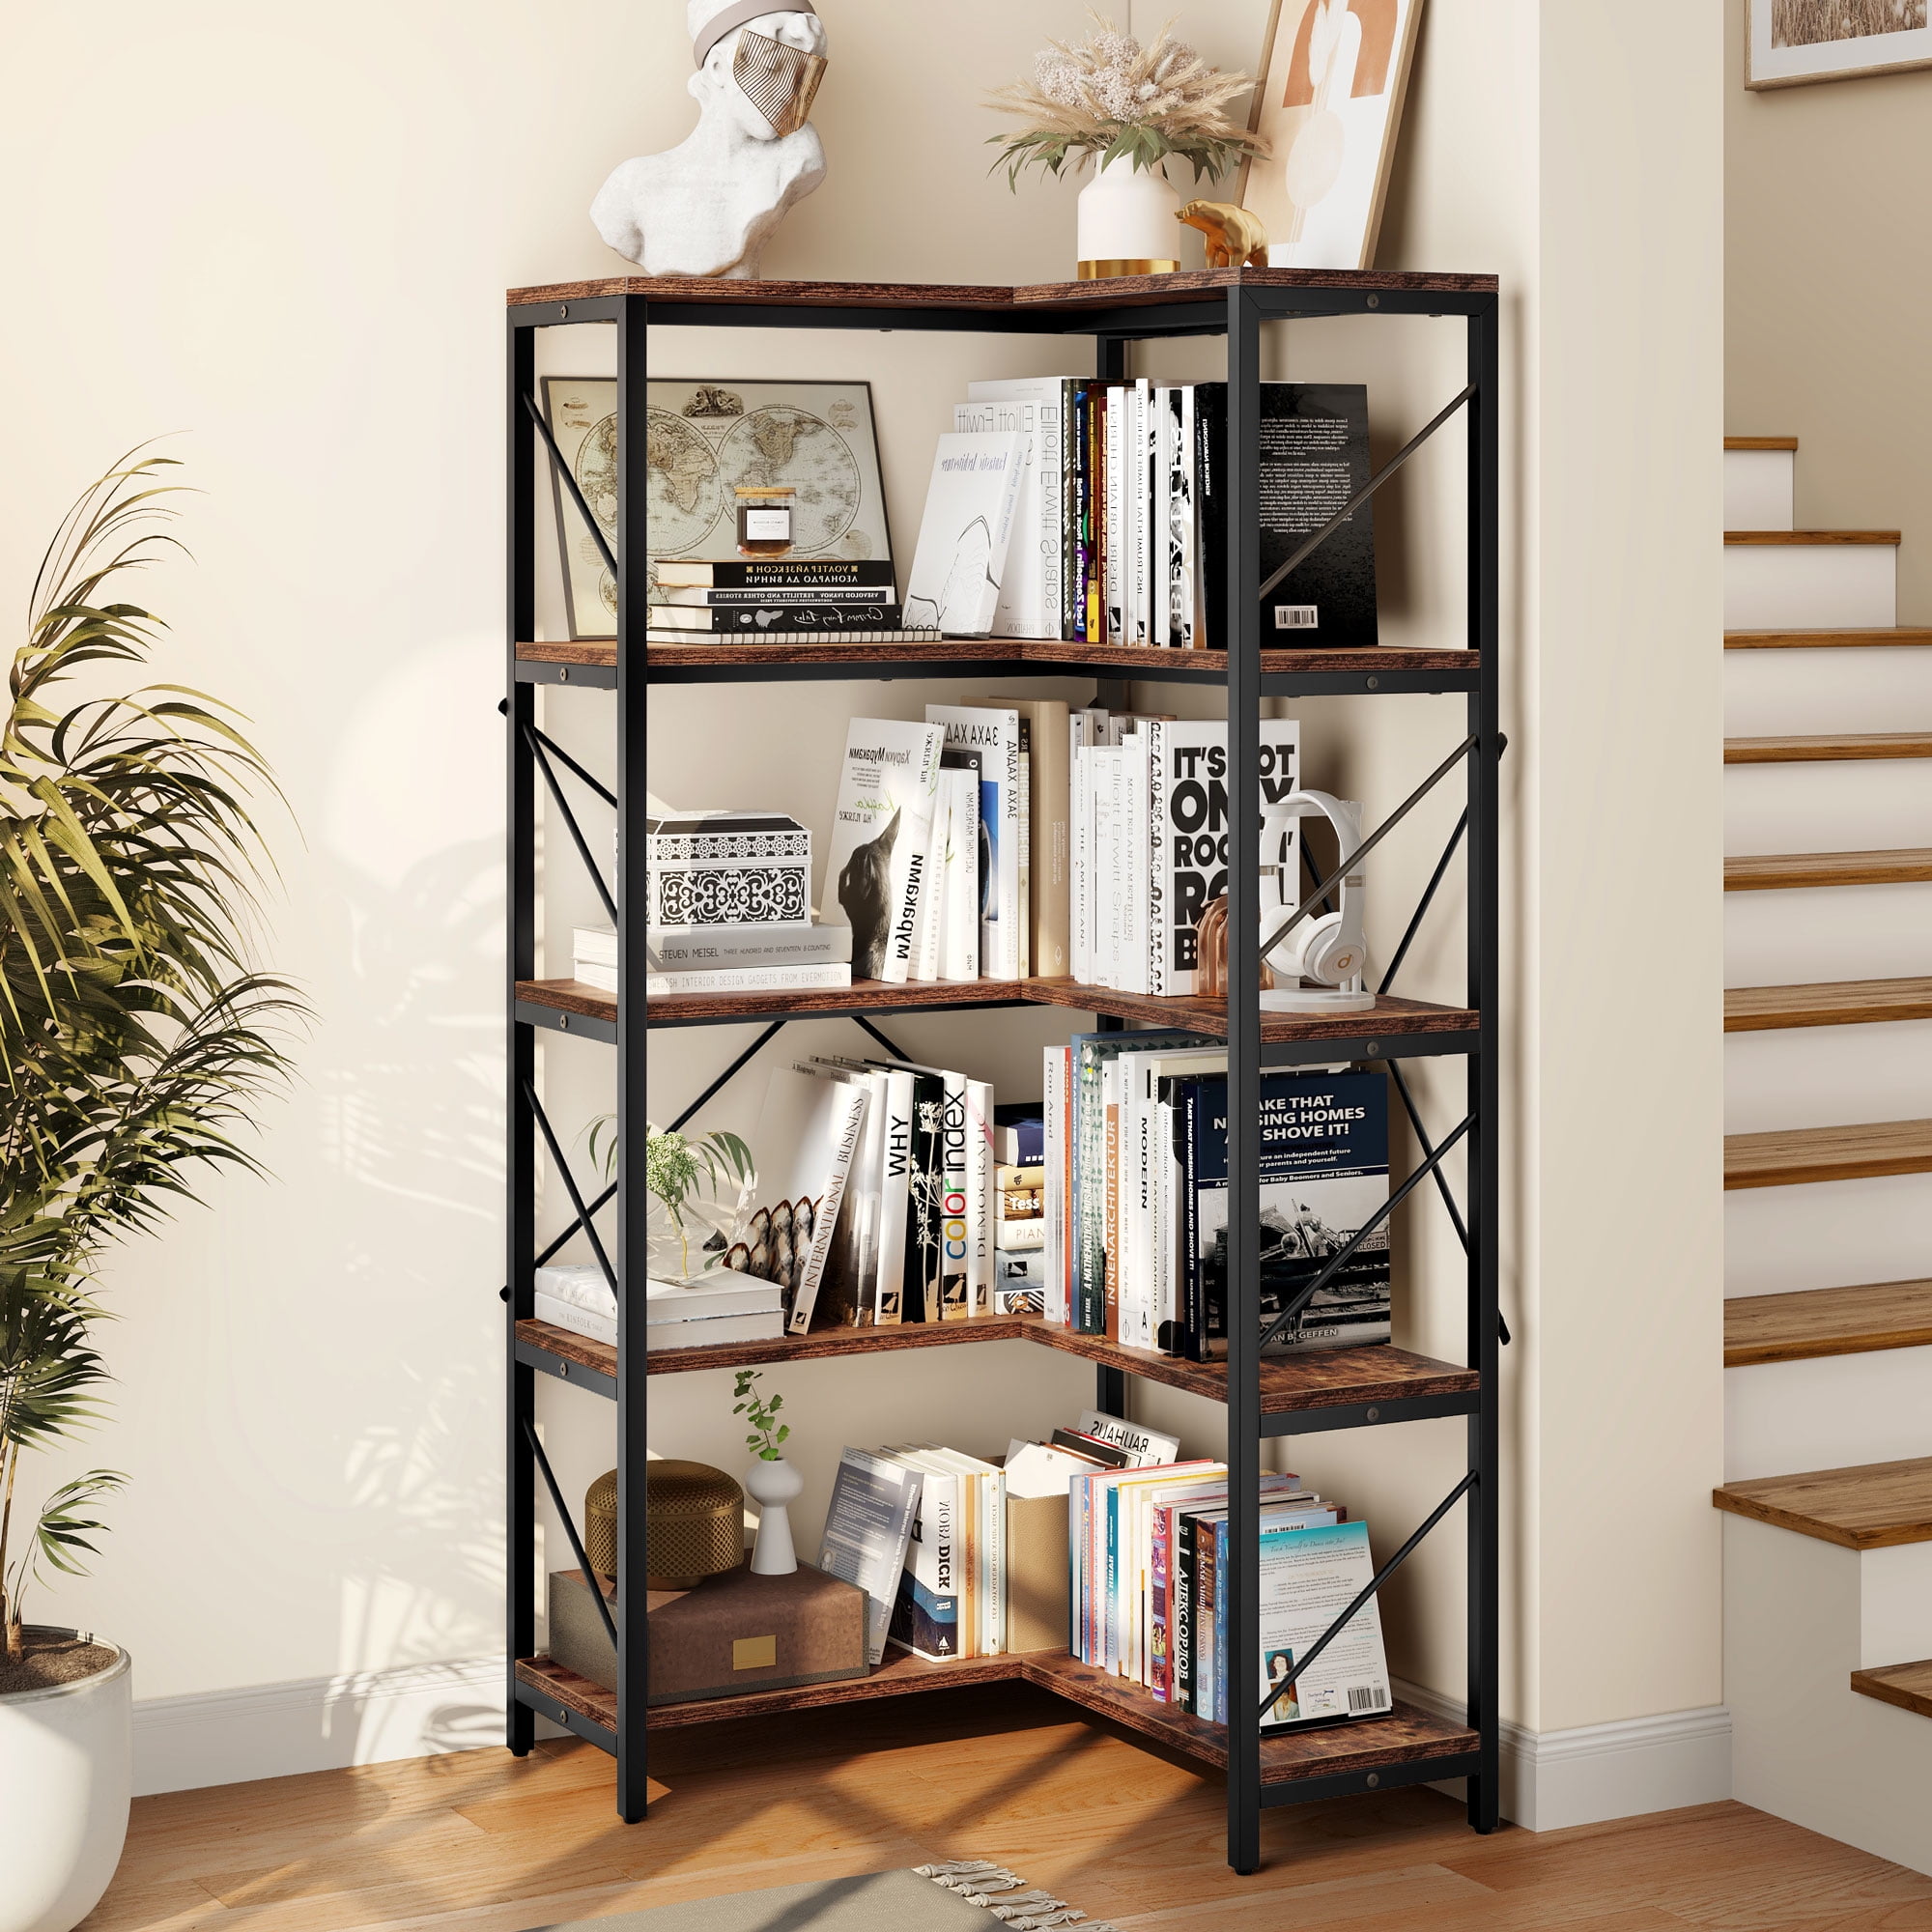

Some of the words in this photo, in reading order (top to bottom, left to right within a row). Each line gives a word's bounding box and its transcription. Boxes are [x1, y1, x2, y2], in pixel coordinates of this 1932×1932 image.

[1174, 746, 1227, 779] IT'S
[1112, 759, 1122, 821] Elliott
[1112, 823, 1122, 883] Erwitt
[659, 948, 688, 960] STEVEN
[692, 947, 719, 958] MEISEL
[740, 947, 762, 955] HUNDRED
[775, 945, 801, 953] SEVENTEEN
[682, 976, 716, 988] INTERIOR
[720, 975, 744, 986] DESIGN
[748, 974, 777, 985] GADGETS
[781, 973, 798, 983] FROM
[801, 971, 842, 983] EVERMOTION
[1259, 1097, 1287, 1112] KE
[1289, 1094, 1334, 1109] THAT
[1300, 1106, 1366, 1123] HOMES
[888, 1115, 909, 1178] WHY
[941, 1090, 966, 1173] index
[1263, 1124, 1324, 1142] SHOVE
[1327, 1122, 1350, 1137] IT!
[1265, 1159, 1293, 1168] parents
[1304, 1155, 1338, 1165] yourself.
[1284, 1150, 1328, 1159] independent
[804, 1172, 845, 1289] INTERNATIONAL
[836, 1097, 865, 1164] BUSINESS
[977, 1113, 986, 1258] DEMOCRATIC
[1270, 1176, 1289, 1184] Baby
[1289, 1173, 1321, 1181] Boomers
[941, 1178, 967, 1261] color
[1009, 1197, 1040, 1211] Tess
[1107, 1121, 1116, 1306] INNENARCHITEKTUR
[1083, 1215, 1093, 1283] MATHEMATICAL
[1358, 1241, 1386, 1251] CLOSED
[1298, 1328, 1337, 1339] GEFFEN
[938, 1545, 951, 1590] DICK
[1179, 1566, 1189, 1623] АЛЕКС
[1179, 1624, 1189, 1680] ОРЛОВ
